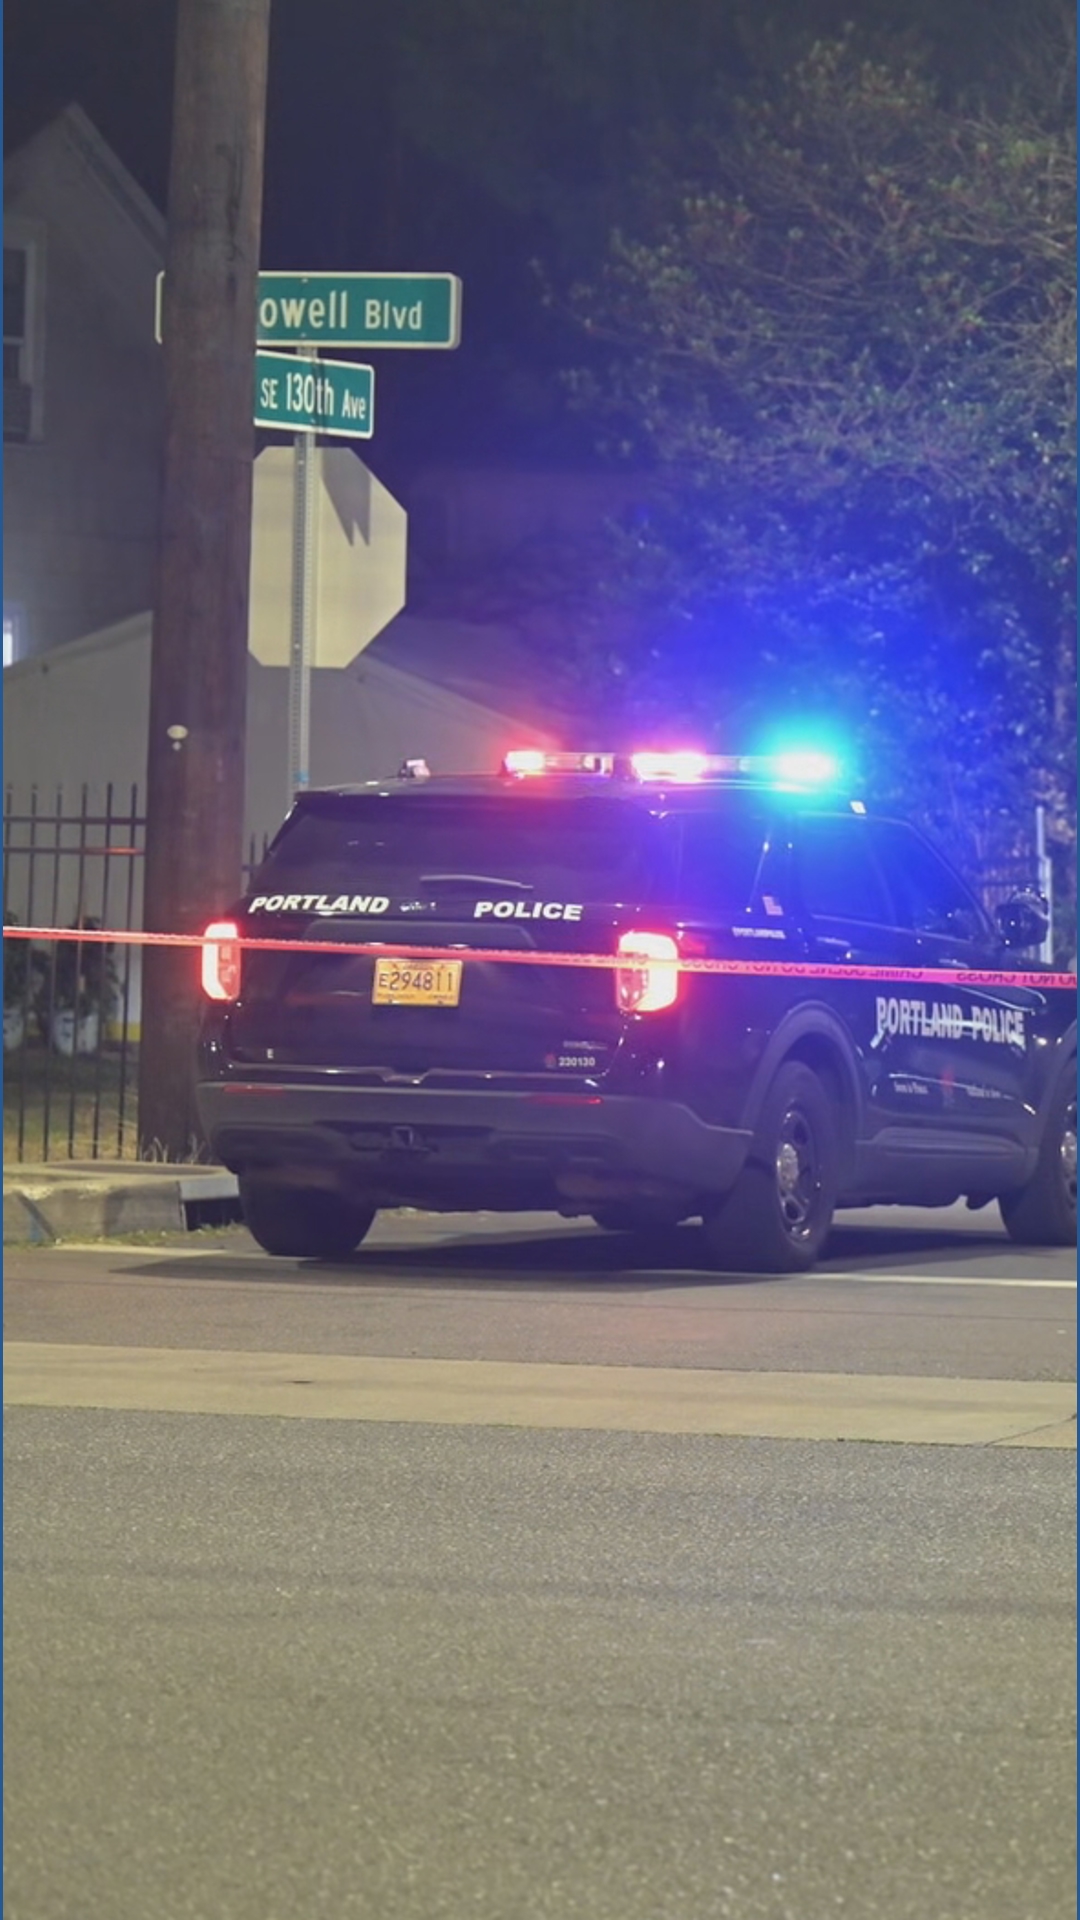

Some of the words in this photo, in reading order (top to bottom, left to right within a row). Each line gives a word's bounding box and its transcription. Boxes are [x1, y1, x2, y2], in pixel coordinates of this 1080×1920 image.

[259, 290, 347, 329] owell
[365, 299, 422, 330] Blvd
[260, 378, 279, 410] SE
[286, 372, 334, 416] 130th
[342, 389, 366, 419] Ave
[248, 895, 389, 914] PORTLAND
[474, 901, 583, 921] POLICE
[379, 971, 453, 992] E294811
[876, 997, 963, 1039] PORTLAND
[971, 1005, 1026, 1047] POLICE
